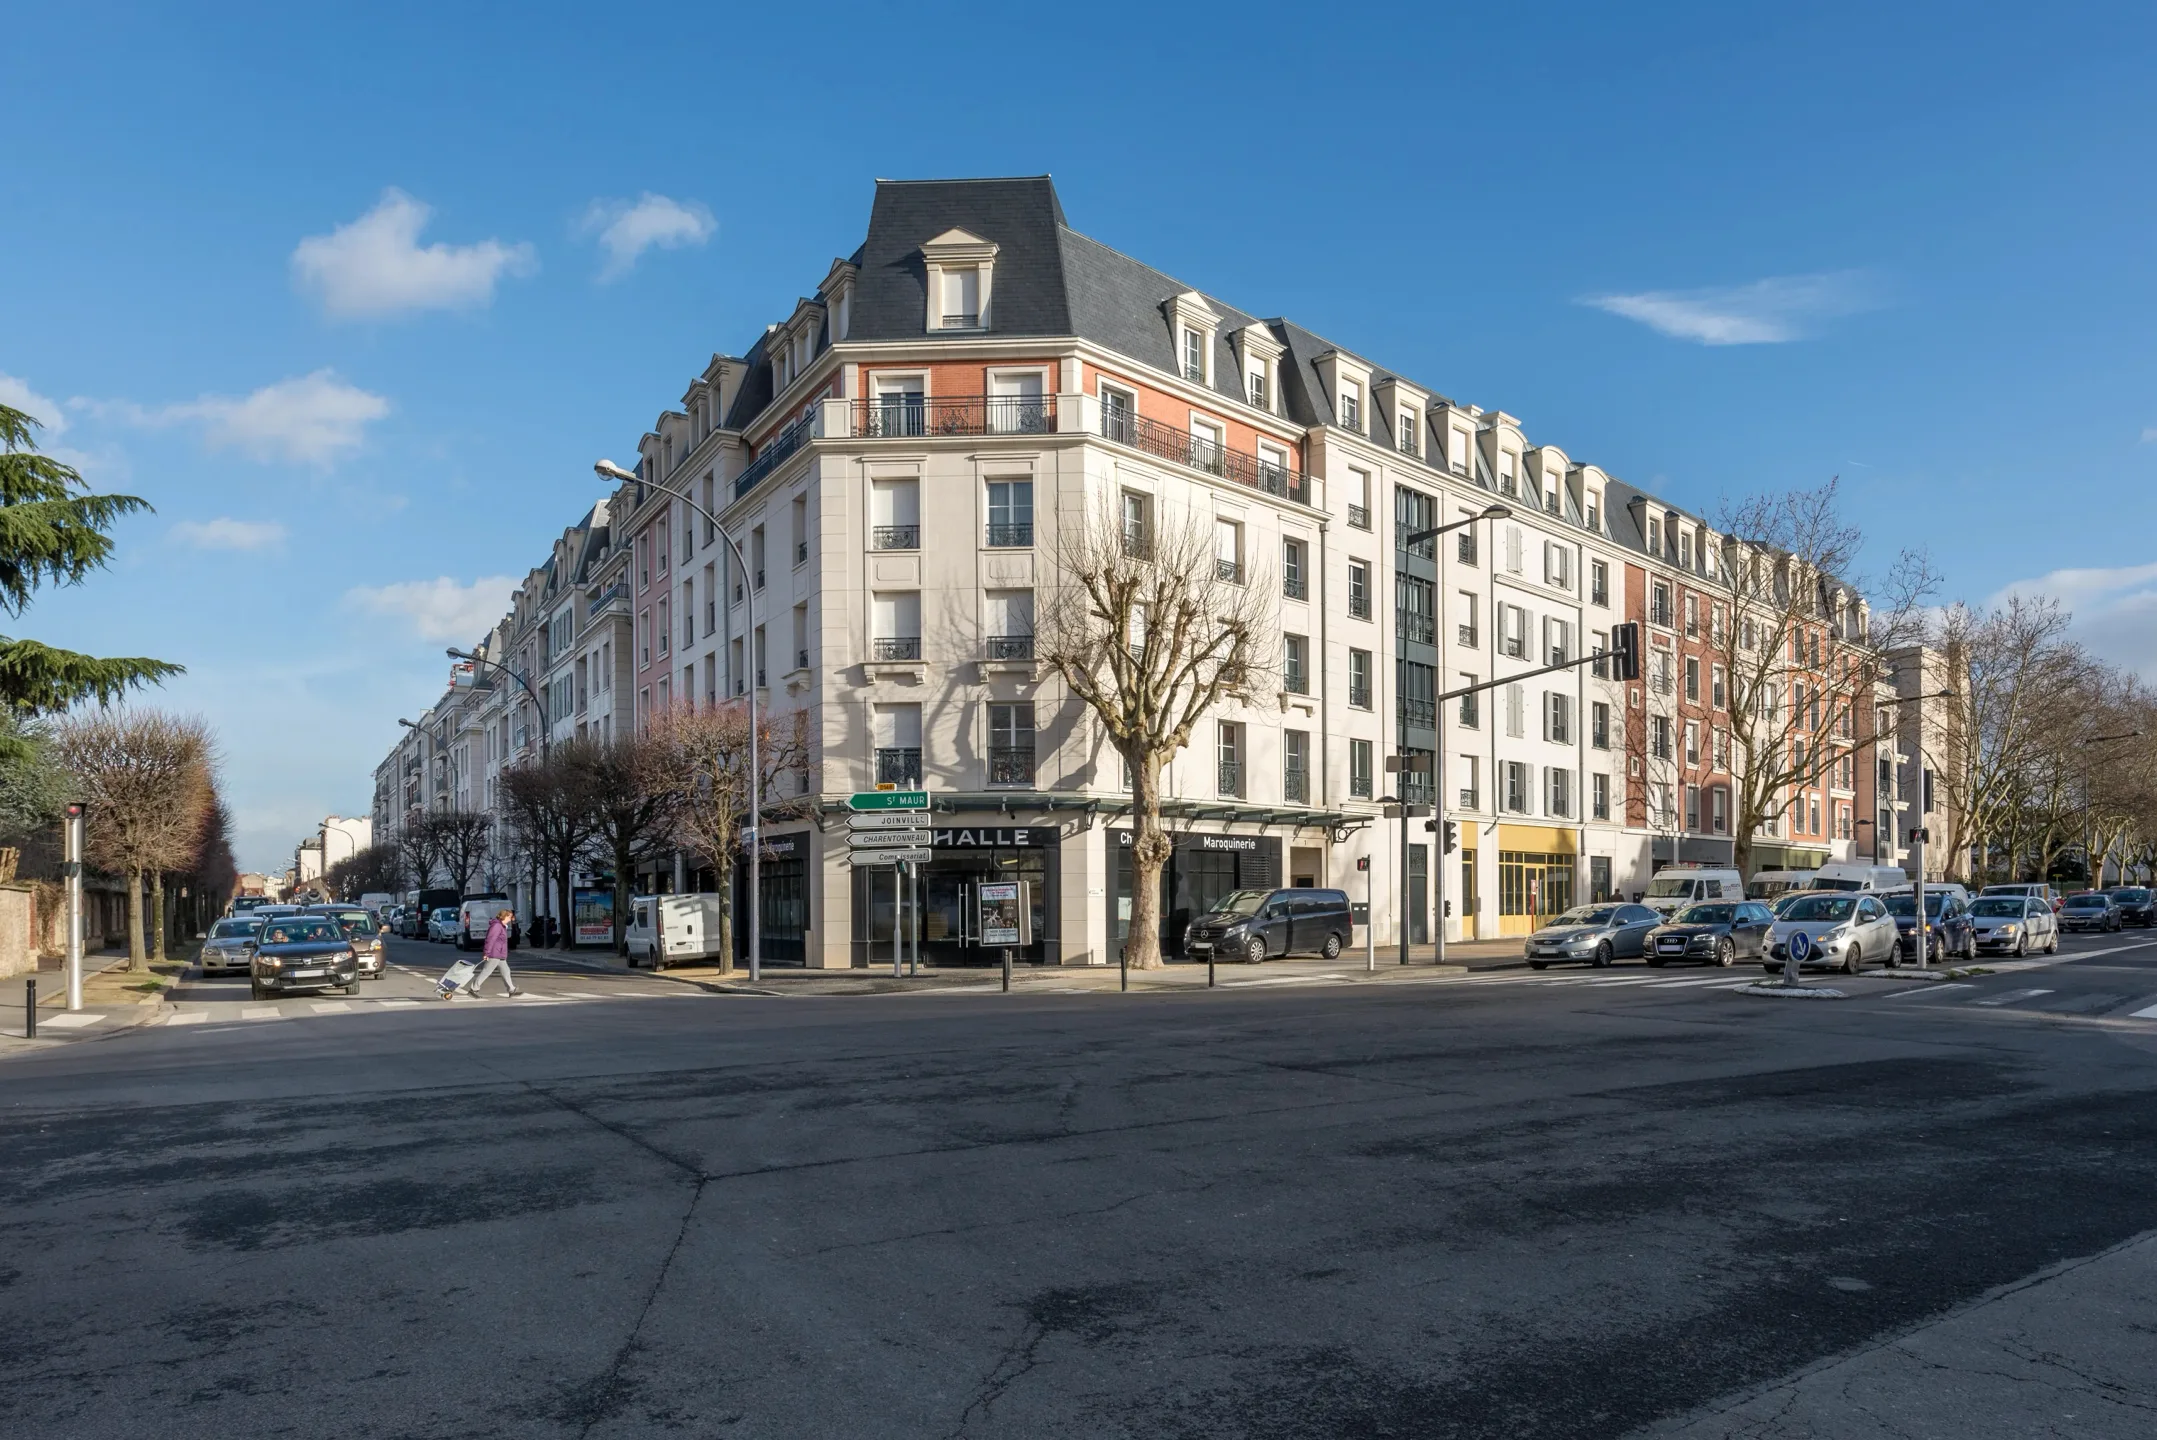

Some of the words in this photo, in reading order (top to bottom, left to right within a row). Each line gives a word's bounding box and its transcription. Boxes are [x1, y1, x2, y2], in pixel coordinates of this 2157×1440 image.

[899, 796, 925, 805] MAUR
[863, 834, 926, 843] CHARENTONNEAU
[933, 829, 1029, 846] HALLE
[1203, 836, 1256, 851] Maroquinerie
